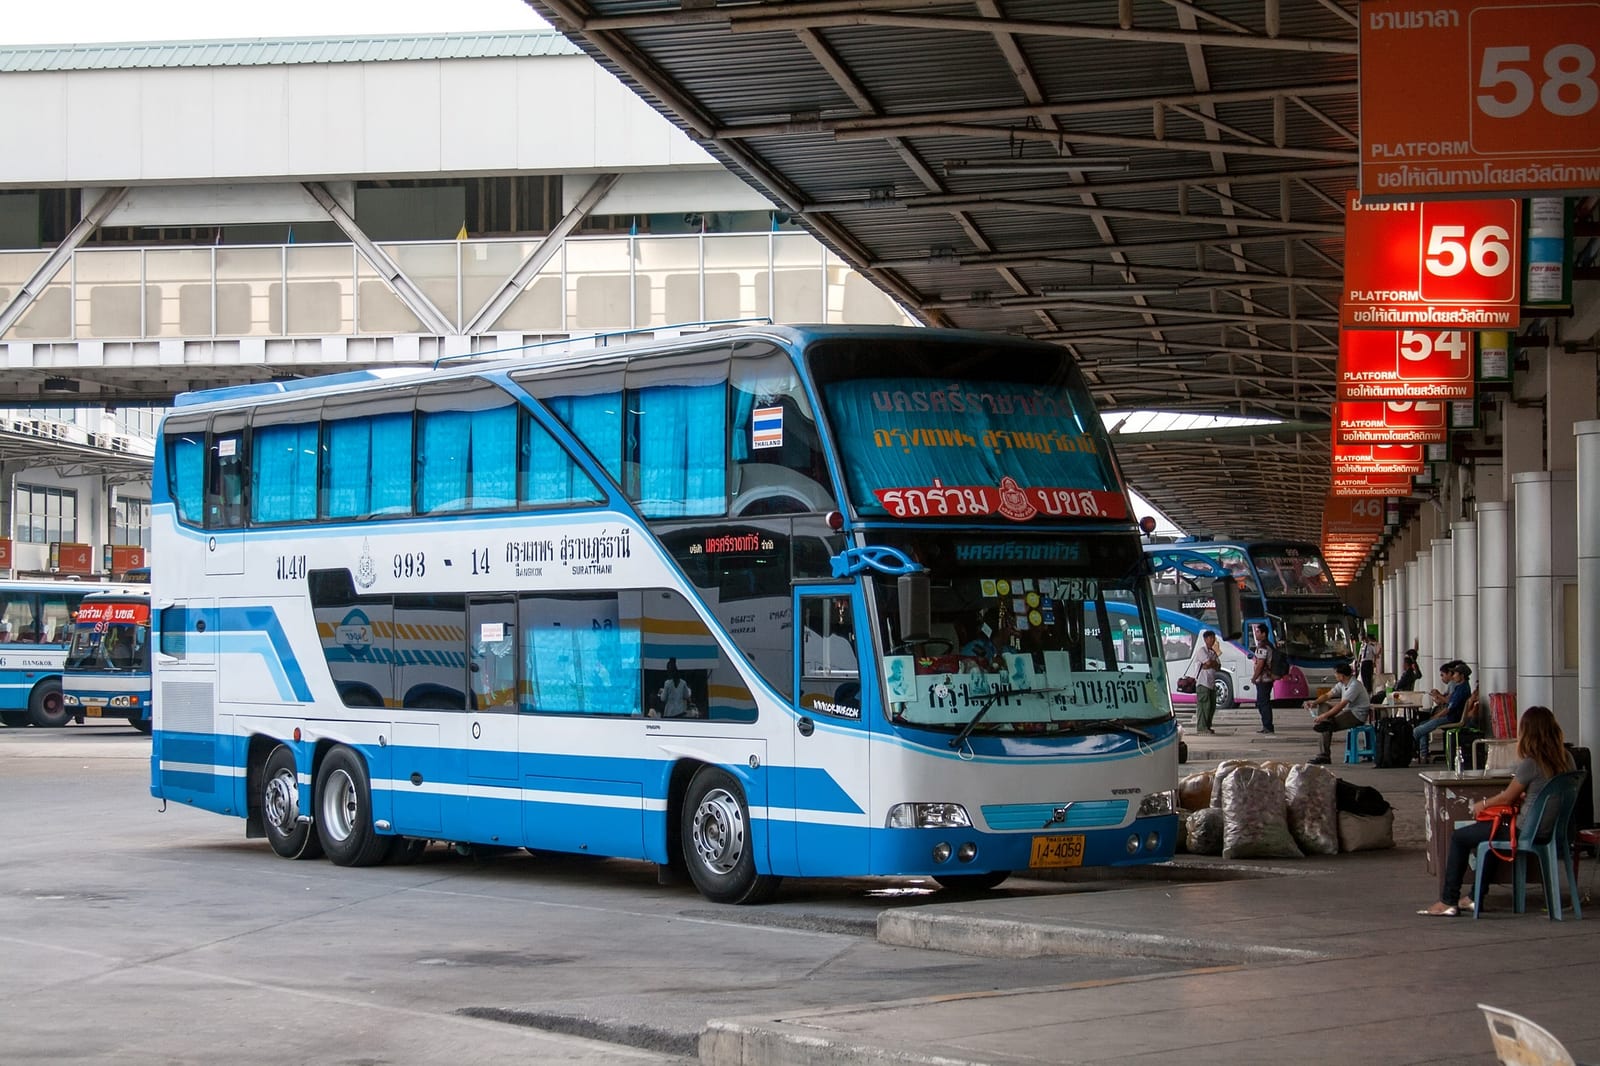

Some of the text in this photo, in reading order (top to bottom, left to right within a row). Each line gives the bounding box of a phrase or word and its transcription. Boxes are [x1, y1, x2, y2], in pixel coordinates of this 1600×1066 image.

[1370, 9, 1460, 30] ชานชาลา
[1476, 43, 1600, 119] 58
[1371, 141, 1469, 158] PLATFORM
[1425, 225, 1510, 277] 56
[1350, 290, 1419, 302] PLATFORM
[1353, 306, 1510, 324] ขอให้เดินทางโดยสวัสดิภาพ
[1400, 330, 1467, 361] 54
[1343, 371, 1397, 381] PLATFORM
[1346, 384, 1467, 397] ขอให้เดินทางโดยสวัสดิภาพ
[1340, 420, 1384, 428] PLATFORM
[754, 439, 781, 448] THAILAND
[883, 478, 988, 516] รถร่วม
[1037, 490, 1108, 517] บขส.
[1352, 499, 1381, 517] 46
[506, 528, 631, 567] กรุงเทพฯ สุราษฎร์ธานี
[78, 553, 87, 564] 4
[130, 555, 139, 565] 3
[393, 551, 426, 578] 993
[471, 547, 491, 575] 14
[515, 567, 543, 577] BANGKOK
[78, 606, 103, 619] รถร่วม
